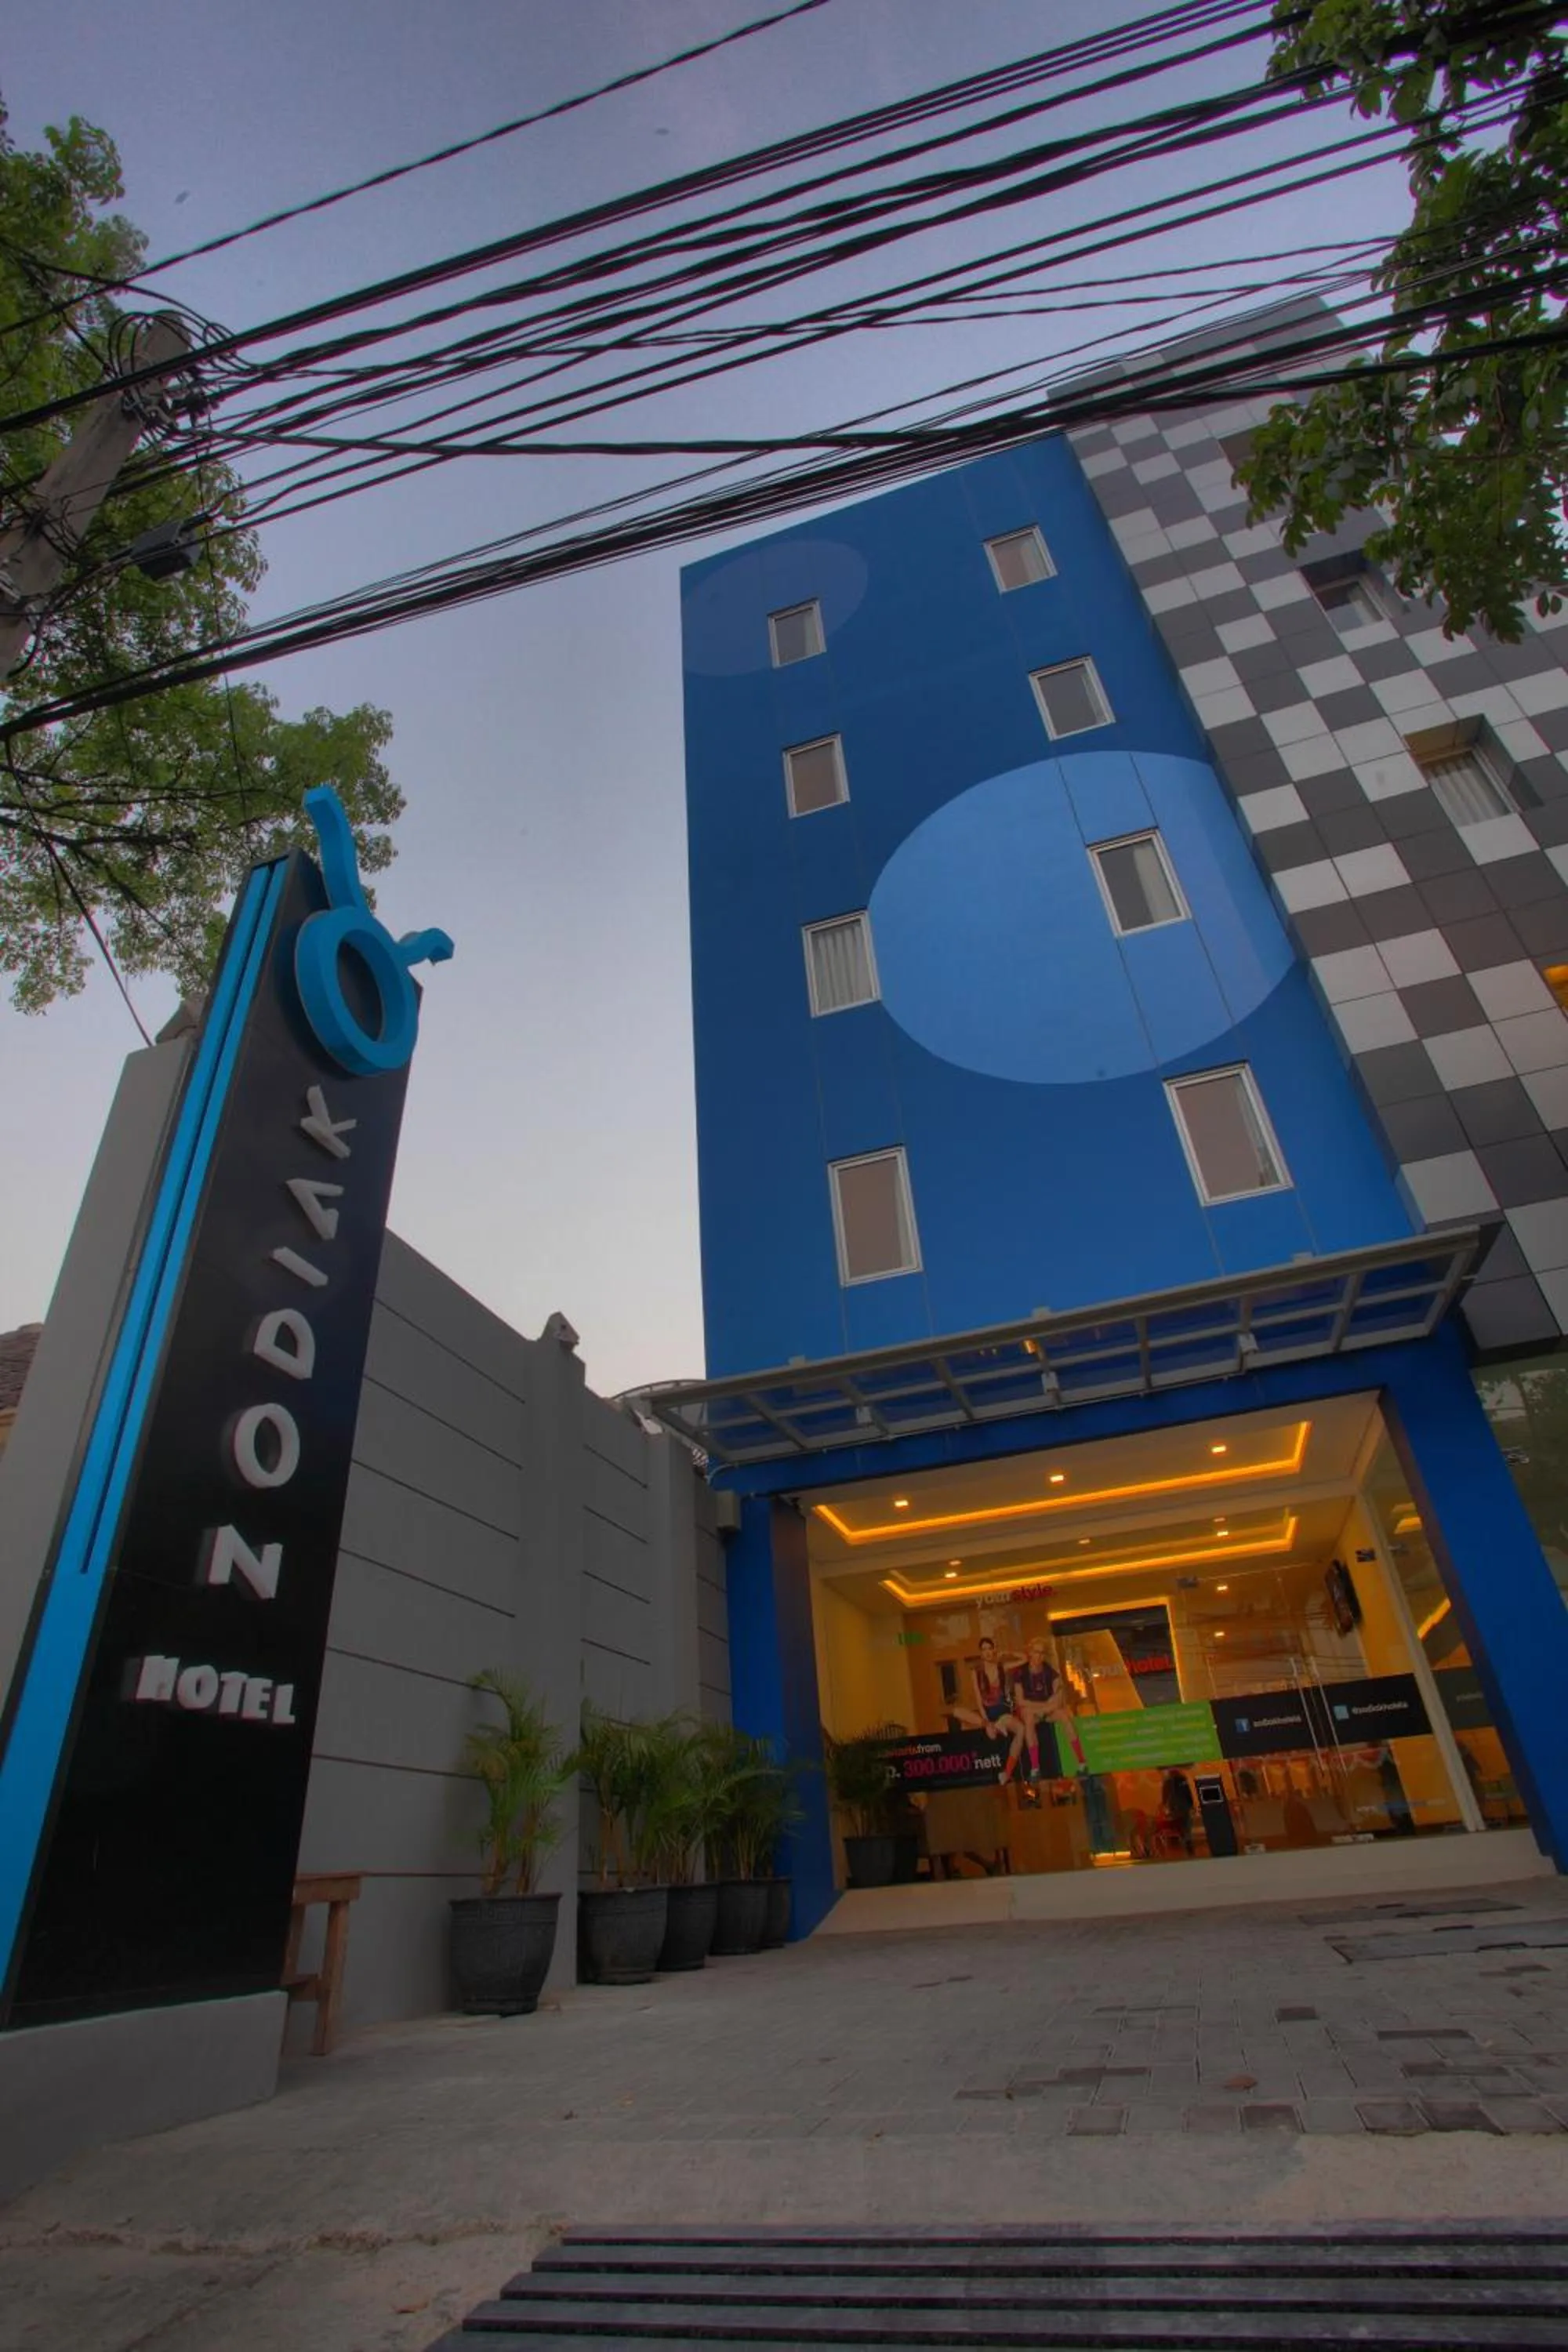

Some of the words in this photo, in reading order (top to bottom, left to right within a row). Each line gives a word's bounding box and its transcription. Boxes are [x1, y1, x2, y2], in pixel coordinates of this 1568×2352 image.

[205, 1083, 358, 1601] ZODIAK
[134, 1653, 297, 1725] HOTEL
[974, 1753, 1002, 1770] nett
